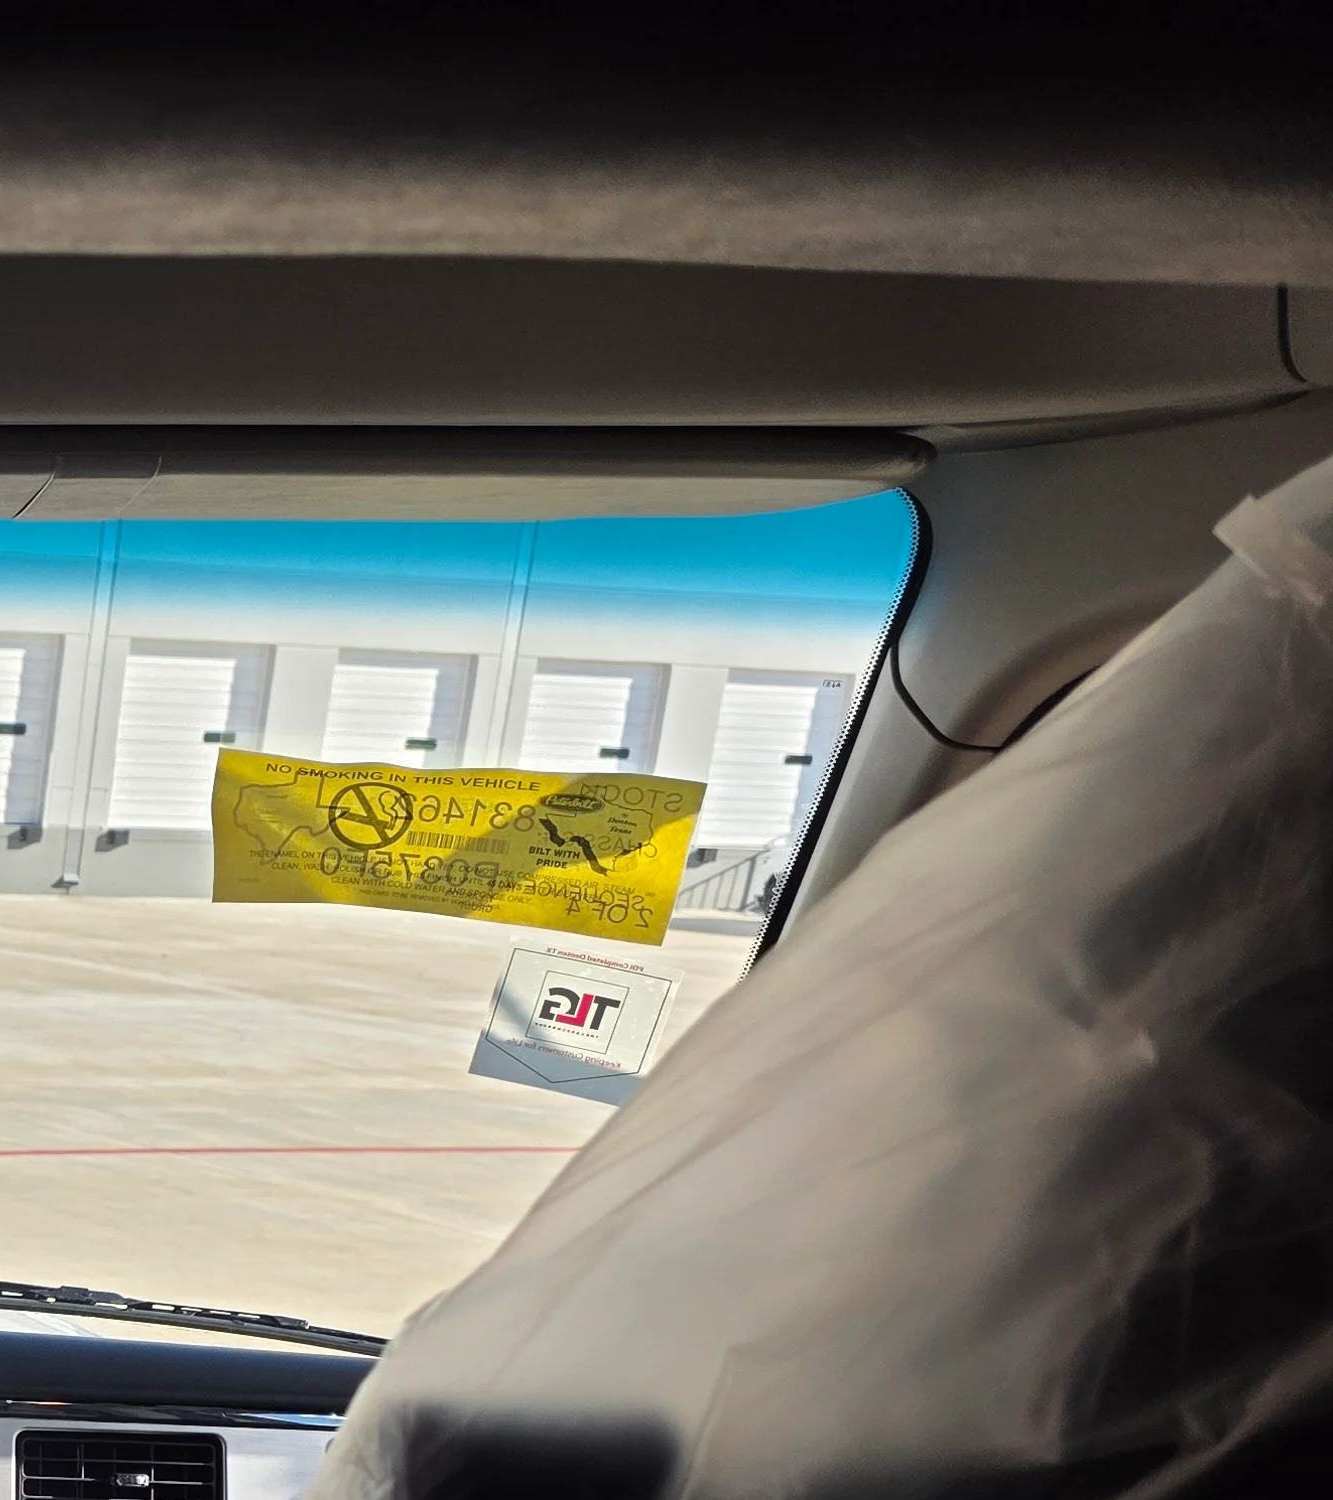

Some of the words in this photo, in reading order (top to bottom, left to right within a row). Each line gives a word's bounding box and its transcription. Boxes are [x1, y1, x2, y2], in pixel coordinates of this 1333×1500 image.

[266, 762, 292, 774] NO
[297, 766, 383, 781] SMOKING
[389, 773, 407, 783] IN
[412, 775, 454, 785] THIS
[460, 776, 542, 792] VEHICLE
[545, 794, 598, 812] Peterbilt
[607, 816, 637, 828] Denton
[528, 845, 551, 857] BILT
[554, 848, 580, 860] WITH
[302, 851, 314, 859] ON
[517, 870, 582, 887] COMPRESSED
[536, 858, 568, 869] PRIDE
[331, 876, 360, 885] CLEAN
[363, 878, 385, 887] WITH
[388, 880, 412, 889] COLD
[414, 883, 446, 894] WATER
